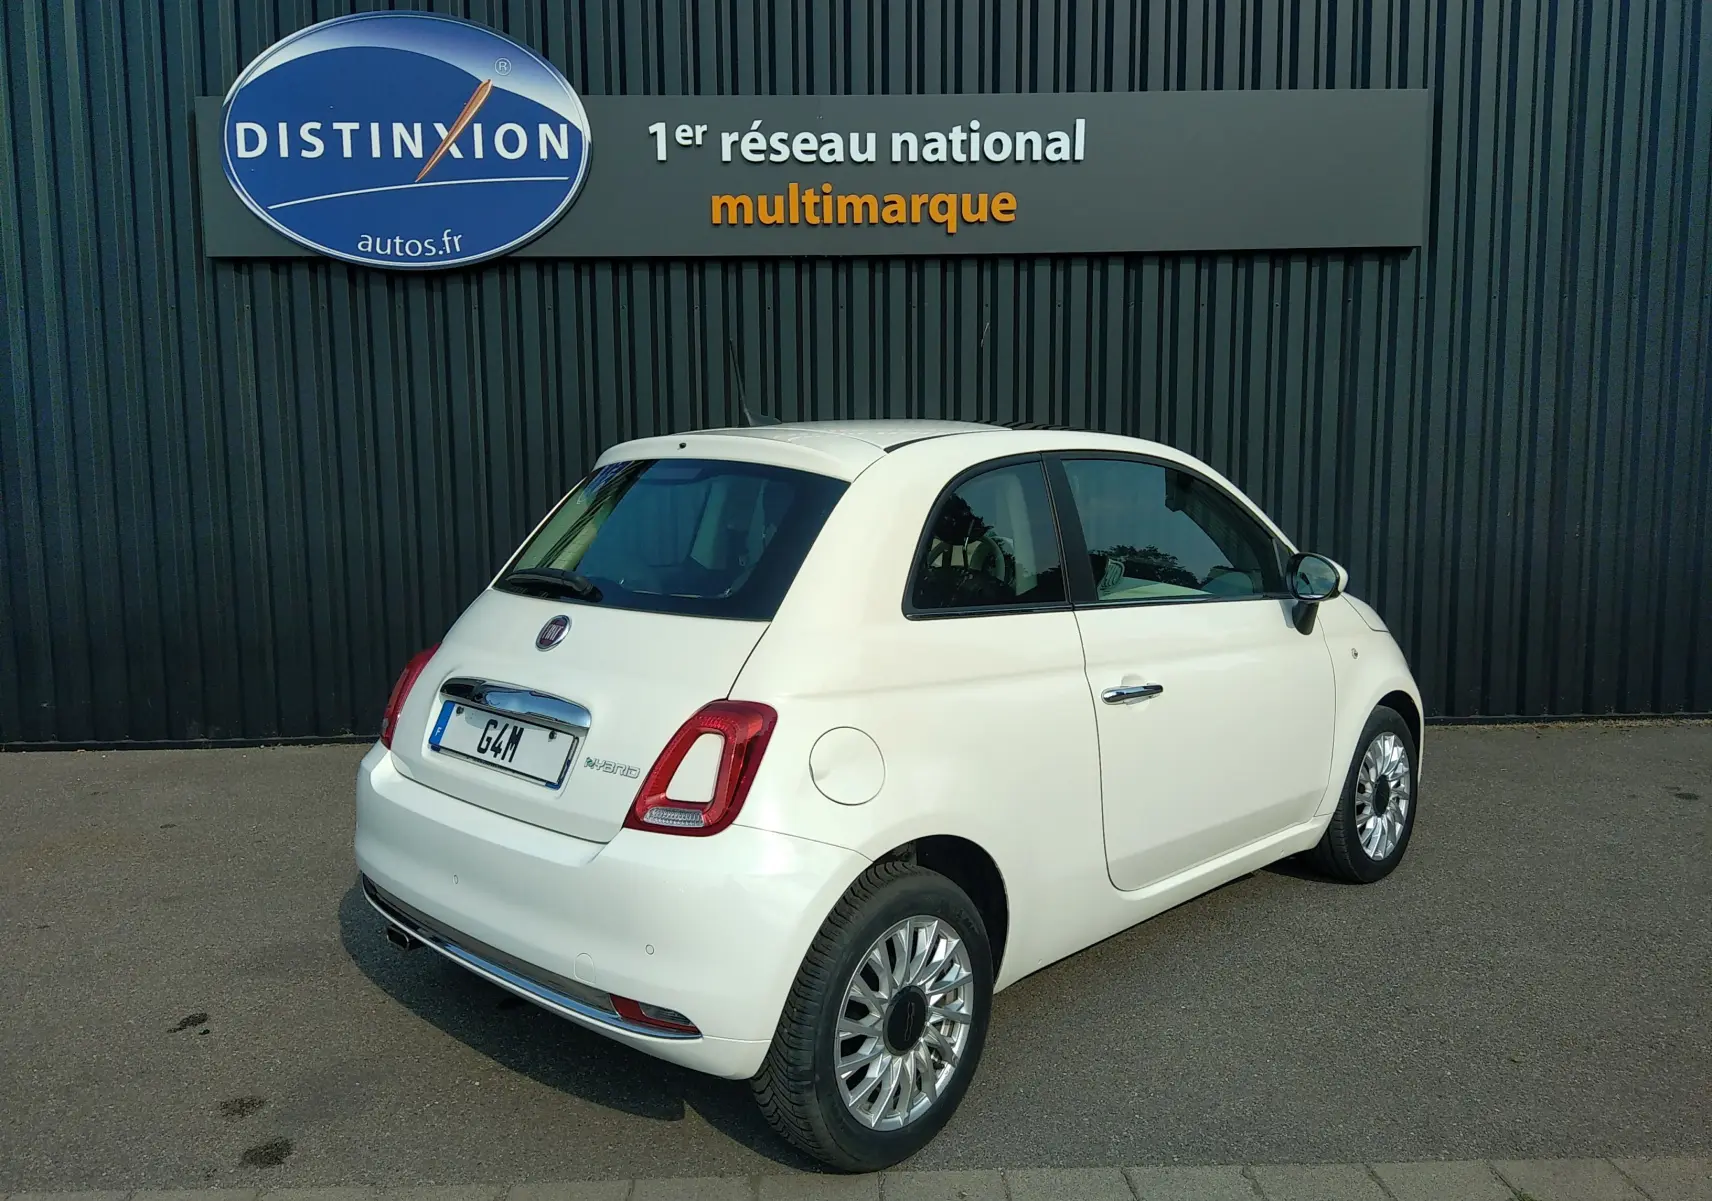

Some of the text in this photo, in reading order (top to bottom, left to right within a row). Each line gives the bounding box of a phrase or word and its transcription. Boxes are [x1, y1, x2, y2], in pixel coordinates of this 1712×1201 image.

[235, 121, 569, 160] DISTINXION
[648, 118, 1086, 164] 1er réseau national
[711, 182, 1018, 234] multimarque
[357, 229, 464, 258] autos.fr
[476, 718, 525, 763] G4M
